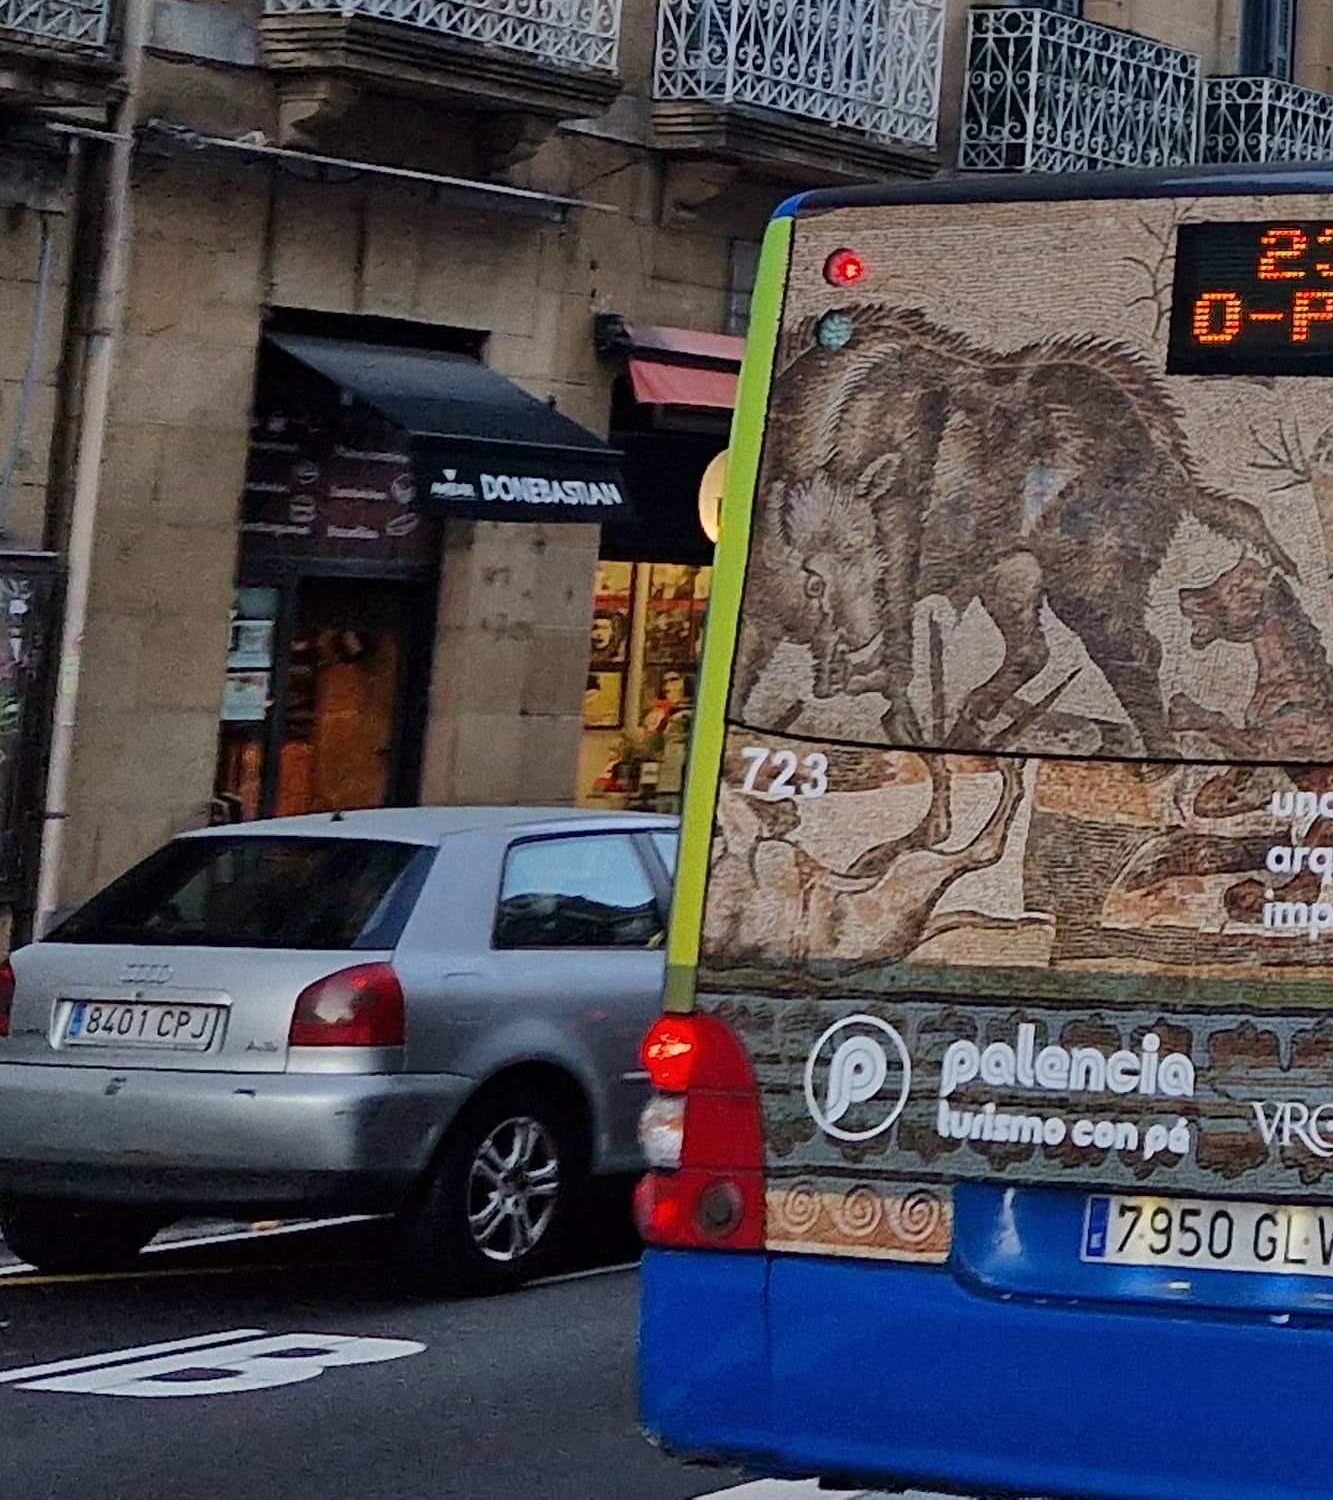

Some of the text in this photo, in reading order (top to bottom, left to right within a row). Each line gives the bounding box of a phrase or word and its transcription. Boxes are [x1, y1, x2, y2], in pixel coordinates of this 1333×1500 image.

[742, 746, 829, 798] 723
[86, 1007, 210, 1039] 8401 CPJ
[941, 1022, 1195, 1098] palencia
[937, 1099, 1192, 1161] turismo con pá
[1117, 1203, 1235, 1259] 7950
